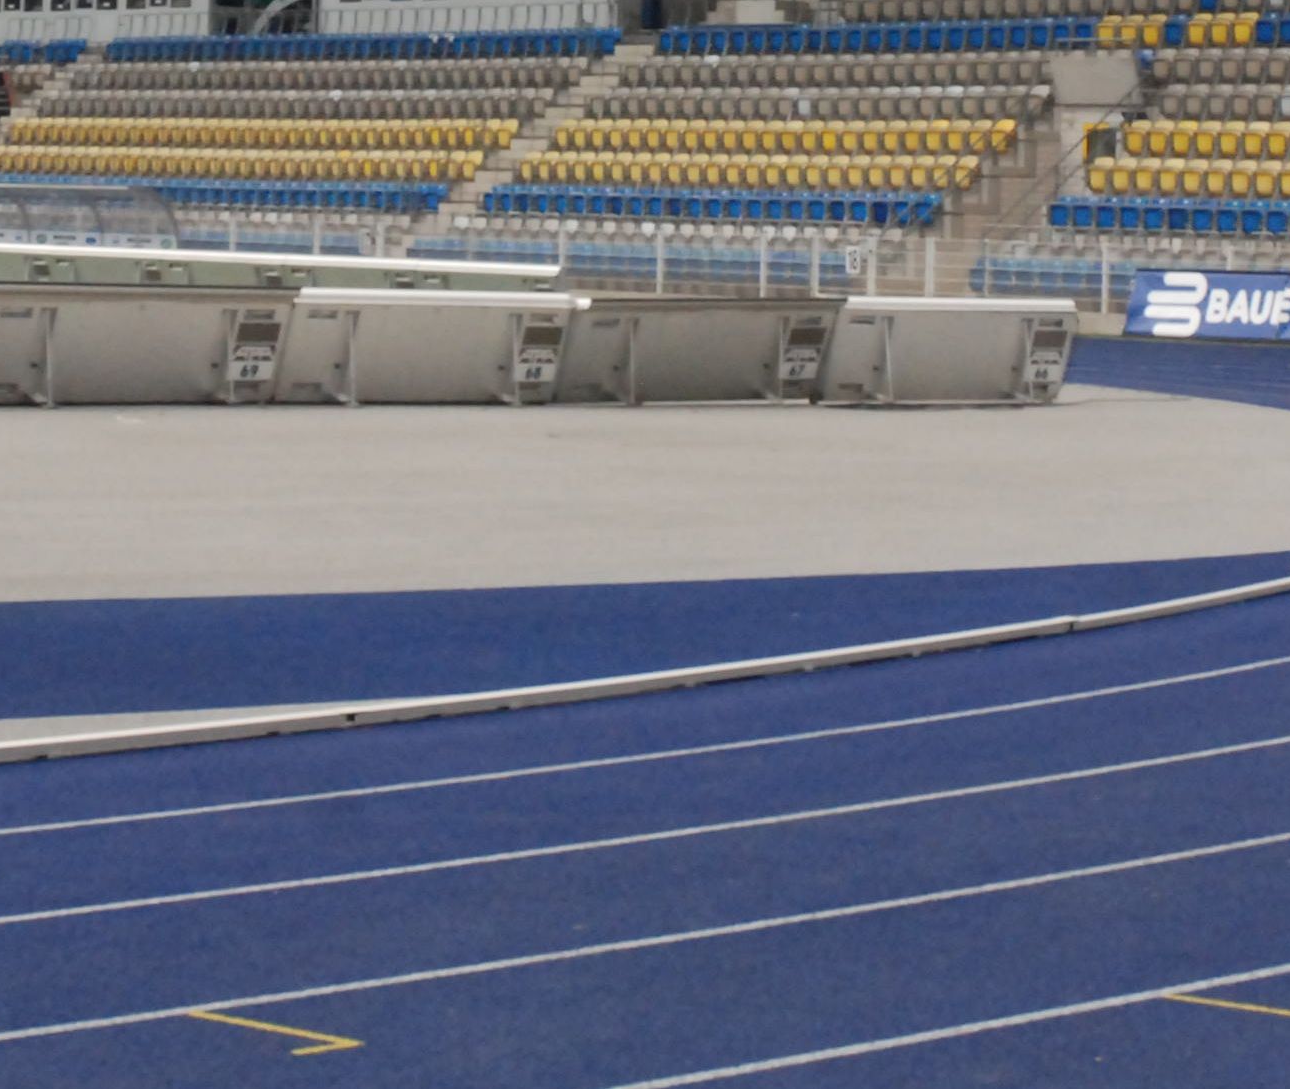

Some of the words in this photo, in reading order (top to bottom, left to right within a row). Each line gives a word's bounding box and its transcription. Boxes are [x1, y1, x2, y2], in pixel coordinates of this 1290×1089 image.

[240, 364, 259, 378] 69
[525, 367, 542, 380] 68
[789, 365, 805, 376] 67
[1035, 368, 1048, 379] 66
